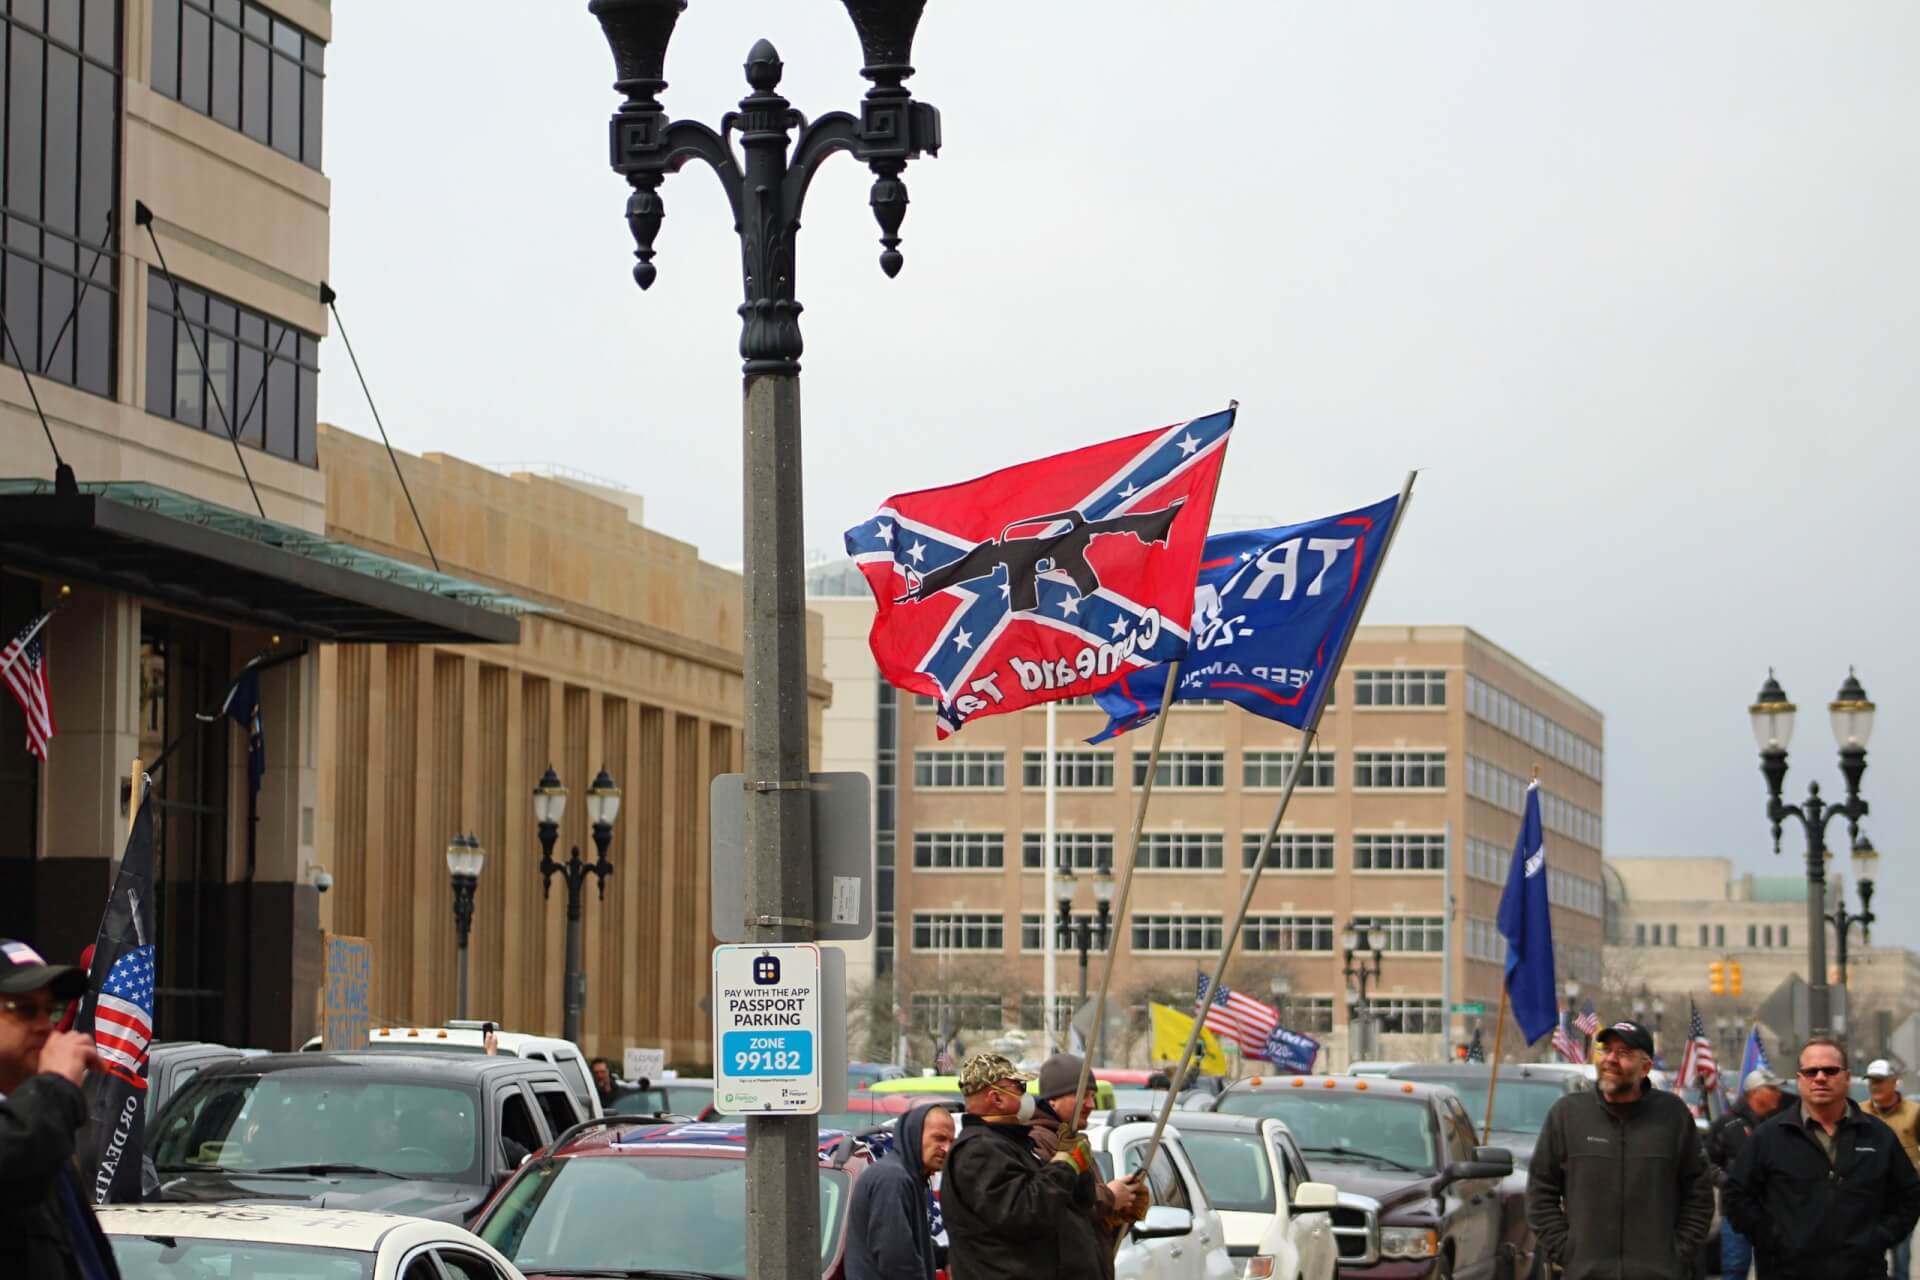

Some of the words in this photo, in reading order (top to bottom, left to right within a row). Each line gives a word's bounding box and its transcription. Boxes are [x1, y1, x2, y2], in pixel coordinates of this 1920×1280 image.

[724, 989, 742, 998] PAY
[743, 988, 769, 997] WITH
[771, 988, 789, 997] THE
[791, 987, 810, 997] APP
[729, 998, 805, 1012] PASSPORT
[734, 1012, 801, 1026] PARKING
[750, 1037, 786, 1049] ZONE
[735, 1051, 801, 1071] 99182
